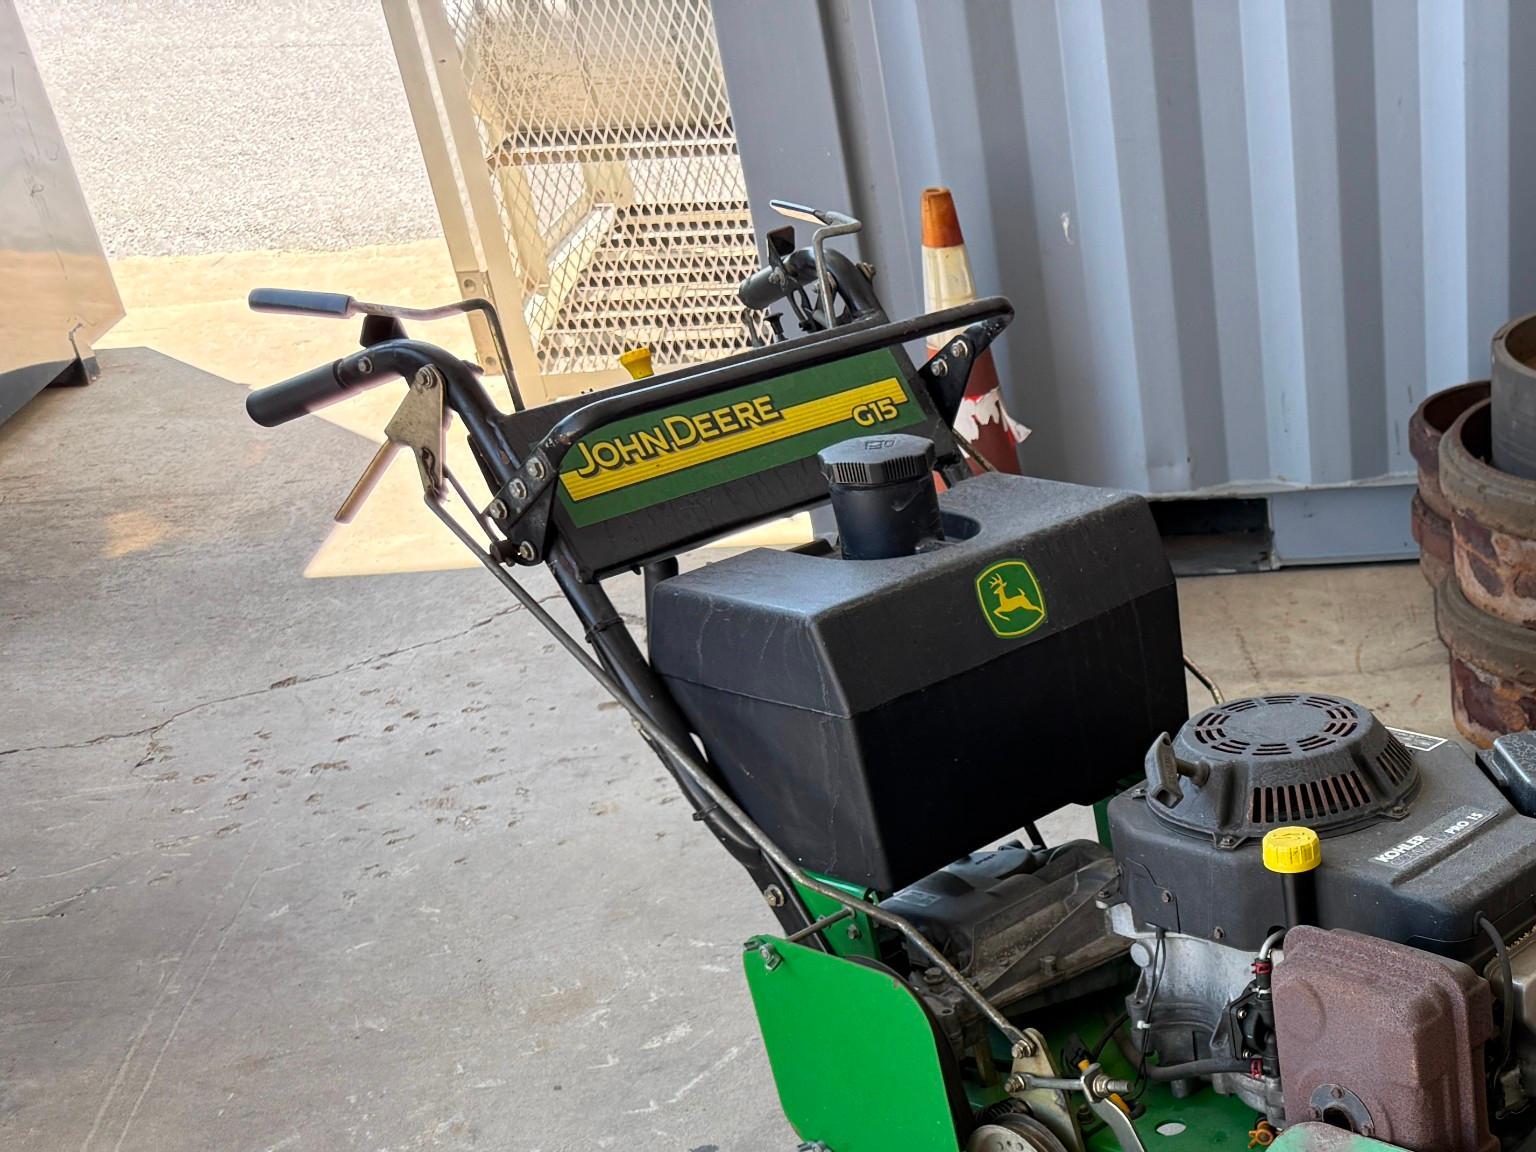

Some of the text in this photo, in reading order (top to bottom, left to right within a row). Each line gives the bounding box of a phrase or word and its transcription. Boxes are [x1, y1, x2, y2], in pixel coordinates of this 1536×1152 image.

[853, 398, 898, 427] G15
[577, 396, 779, 475] JOHN DEERE
[1444, 812, 1483, 835] PRO 15
[1375, 835, 1431, 862] KOHLER
